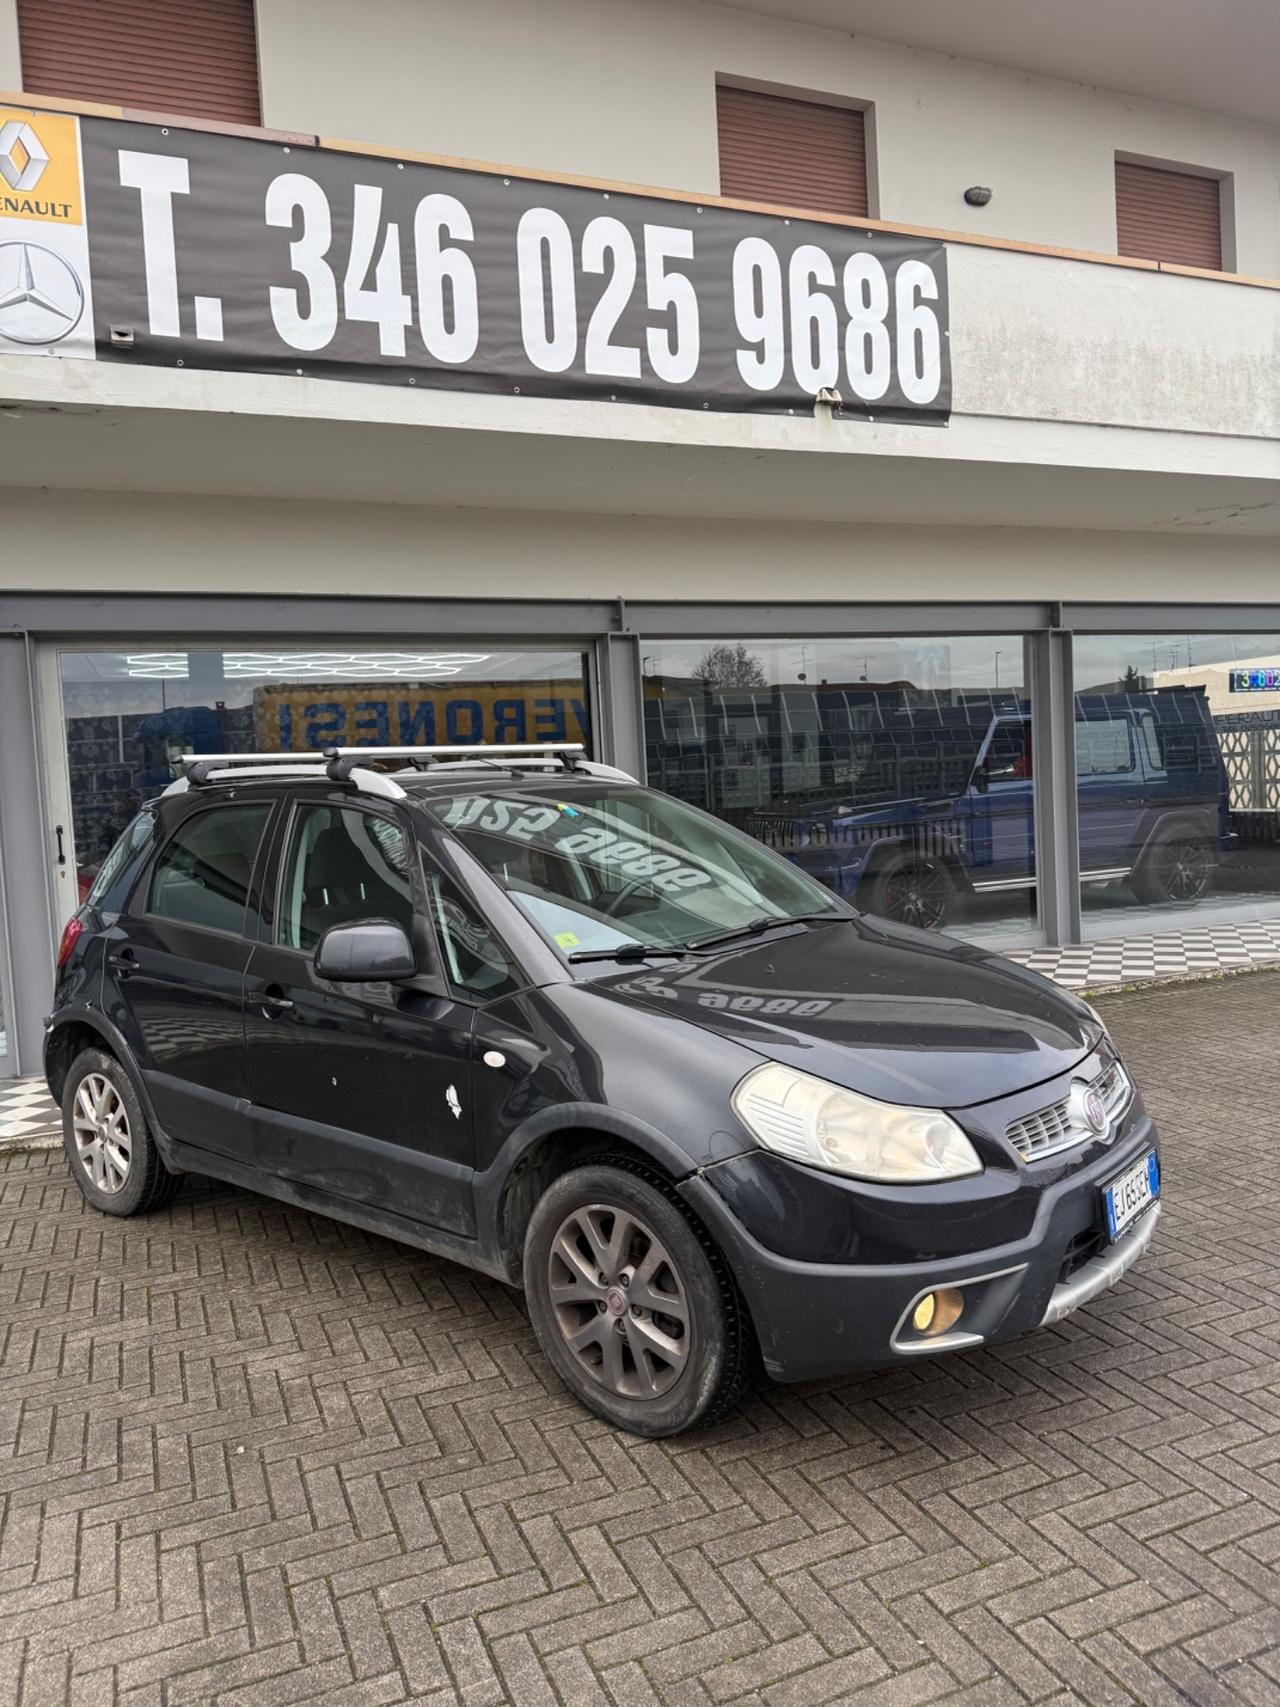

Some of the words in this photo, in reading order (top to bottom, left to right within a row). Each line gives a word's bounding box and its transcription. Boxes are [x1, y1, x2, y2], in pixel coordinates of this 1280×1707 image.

[0, 196, 72, 218] NAULT
[118, 150, 224, 342] T.
[265, 173, 479, 364] 346
[516, 207, 700, 383] 025
[732, 237, 942, 404] 9686
